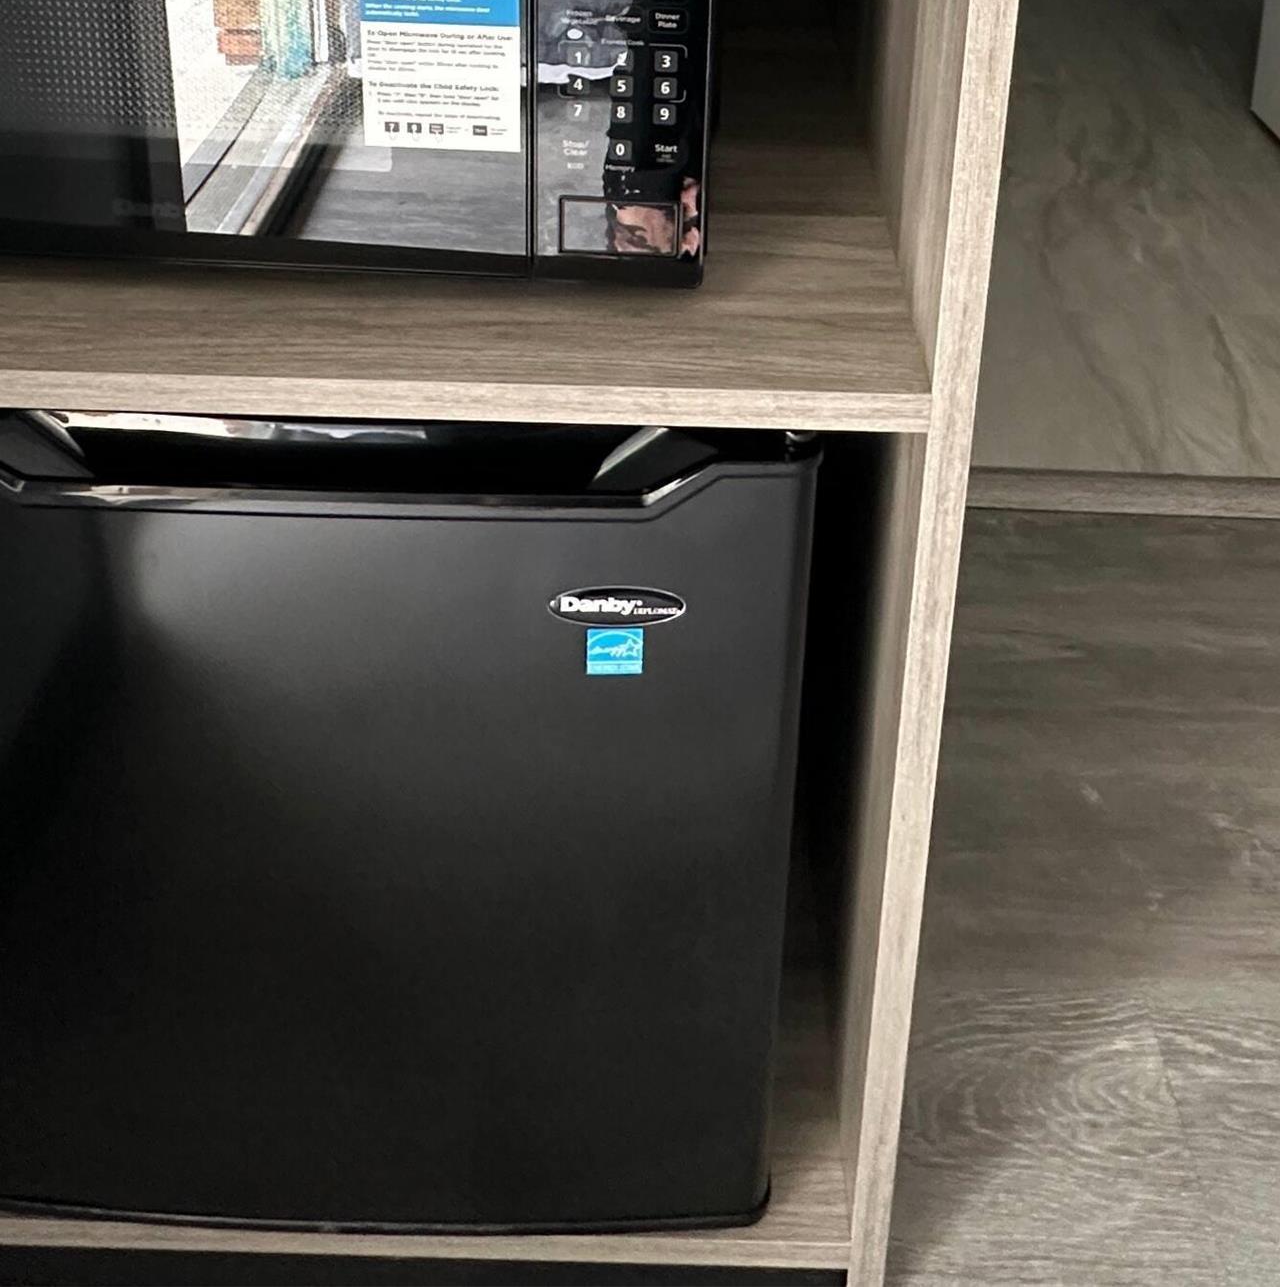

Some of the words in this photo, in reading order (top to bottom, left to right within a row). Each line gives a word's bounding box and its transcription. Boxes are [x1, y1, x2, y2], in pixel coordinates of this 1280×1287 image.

[658, 20, 678, 29] Plate
[574, 51, 582, 64] 1
[661, 55, 671, 68] 3
[573, 78, 583, 90] 4
[616, 79, 627, 93] 5
[660, 81, 670, 94] 6
[573, 104, 582, 117] 7
[616, 105, 626, 119] 8
[660, 108, 670, 121] 9
[615, 143, 625, 156] 0
[654, 144, 678, 153] Start
[560, 596, 636, 616] Danby
